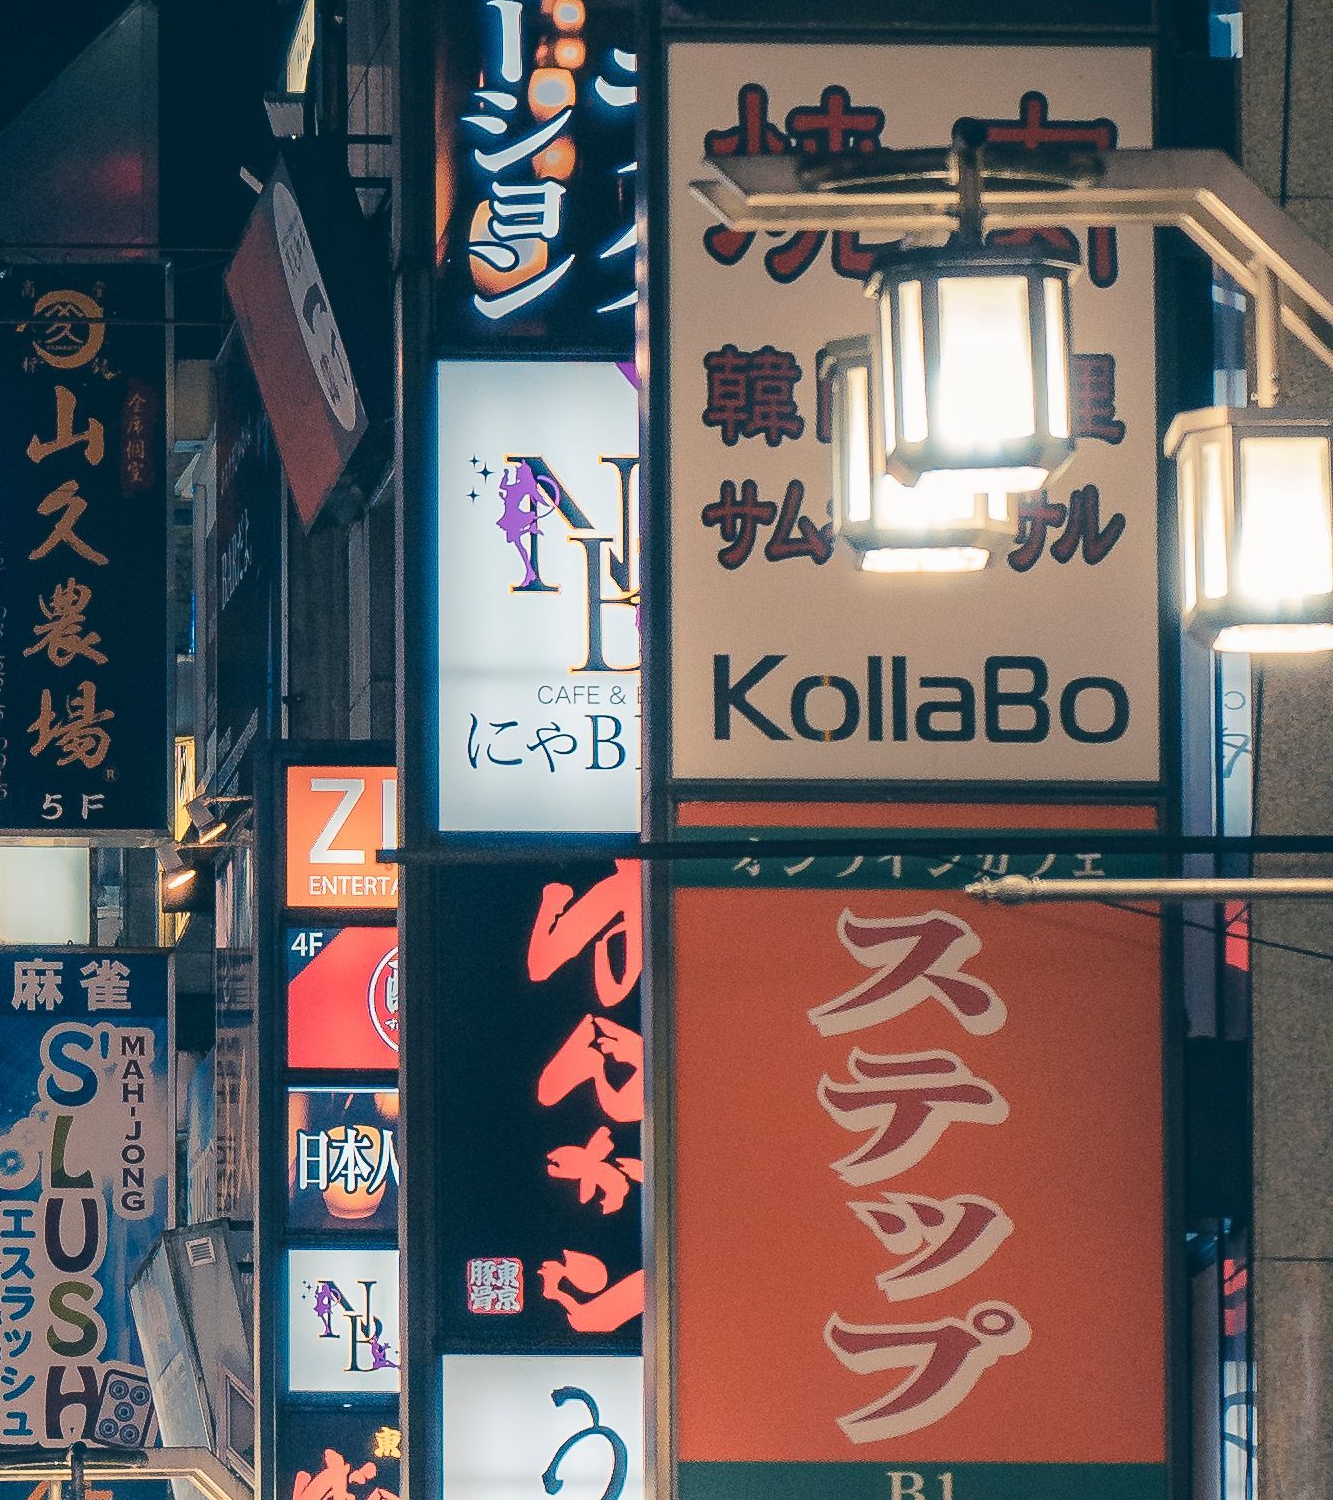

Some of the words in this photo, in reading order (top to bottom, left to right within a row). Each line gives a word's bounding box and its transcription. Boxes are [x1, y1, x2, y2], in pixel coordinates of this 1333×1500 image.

[24, 387, 111, 768] 山久農場
[712, 655, 1131, 745] KollaBo
[42, 793, 104, 820] 5F
[291, 932, 324, 956] 4F
[13, 960, 132, 1011] 麻雀
[806, 907, 1032, 1444] ステップ
